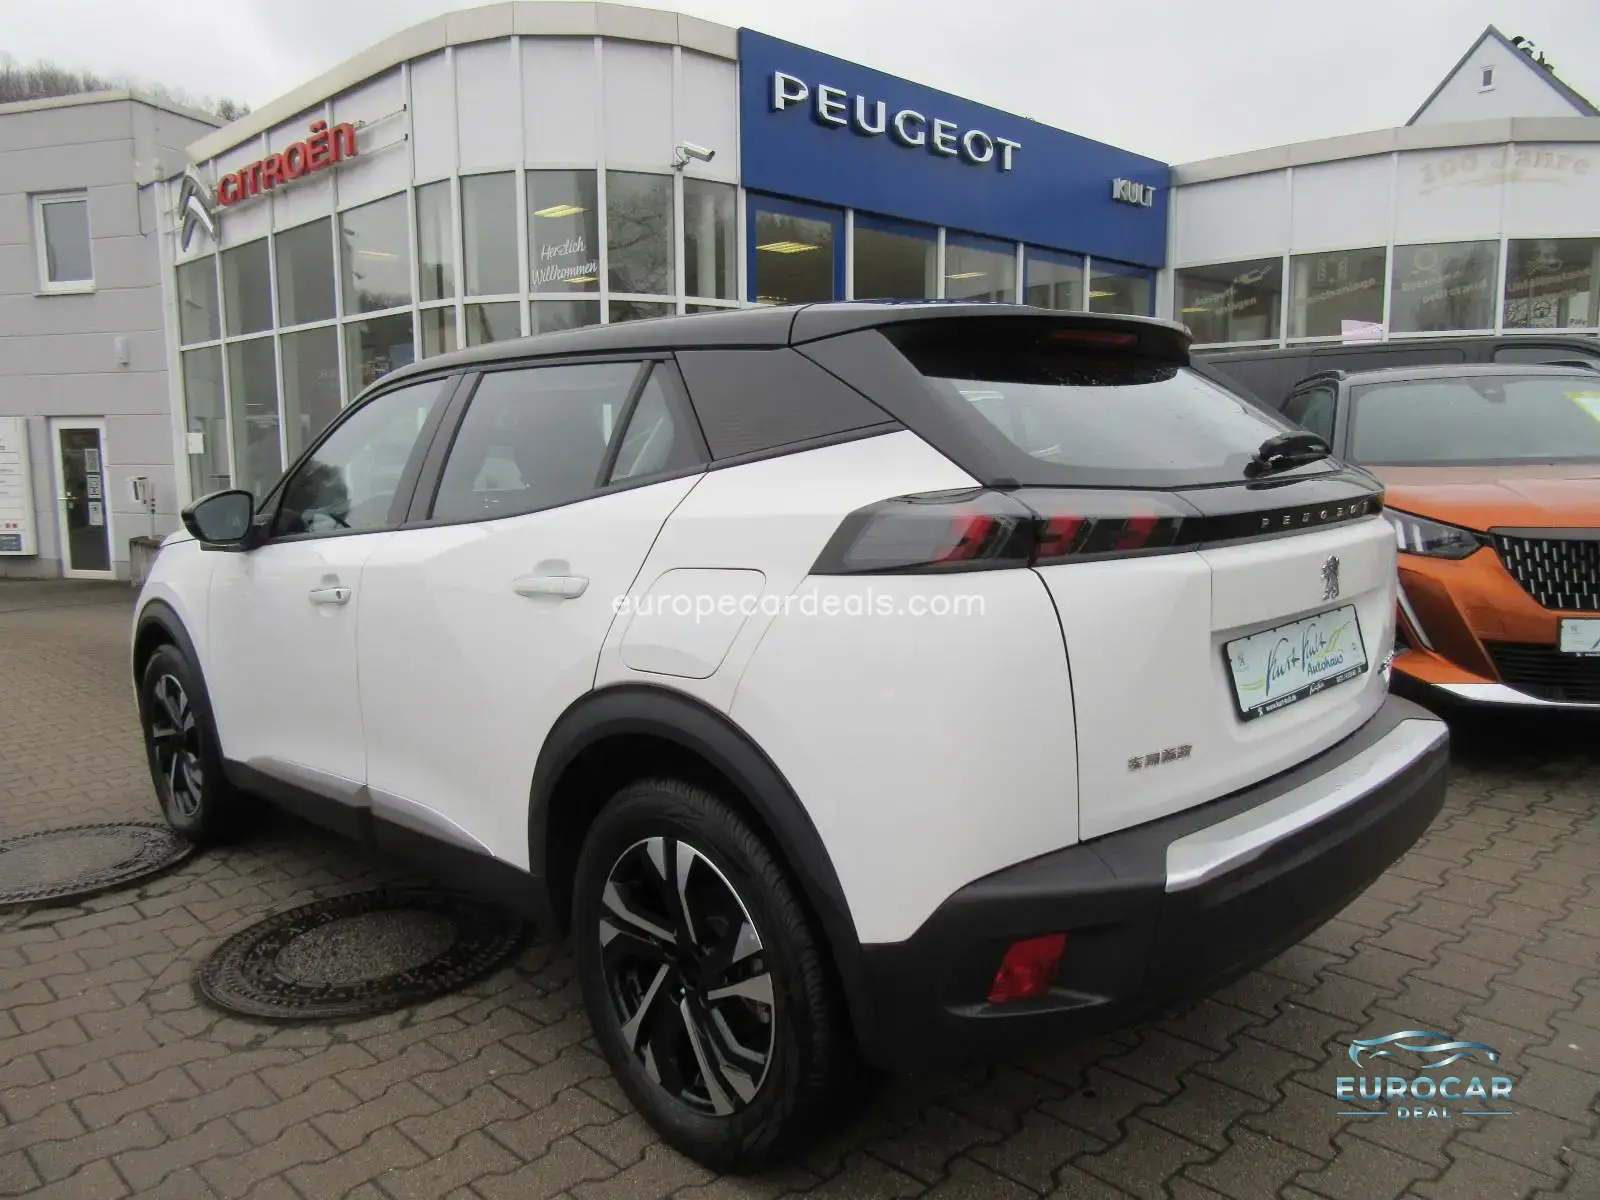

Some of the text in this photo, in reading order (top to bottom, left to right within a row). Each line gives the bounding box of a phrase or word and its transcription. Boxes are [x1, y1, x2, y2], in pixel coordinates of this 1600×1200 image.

[772, 70, 1022, 172] PEUGEOT
[1112, 178, 1157, 208] KULT
[541, 236, 586, 260] Herzlich
[532, 259, 598, 286] Willkommen
[1261, 500, 1369, 528] PEUGEOT
[1307, 653, 1345, 677] Autohaus
